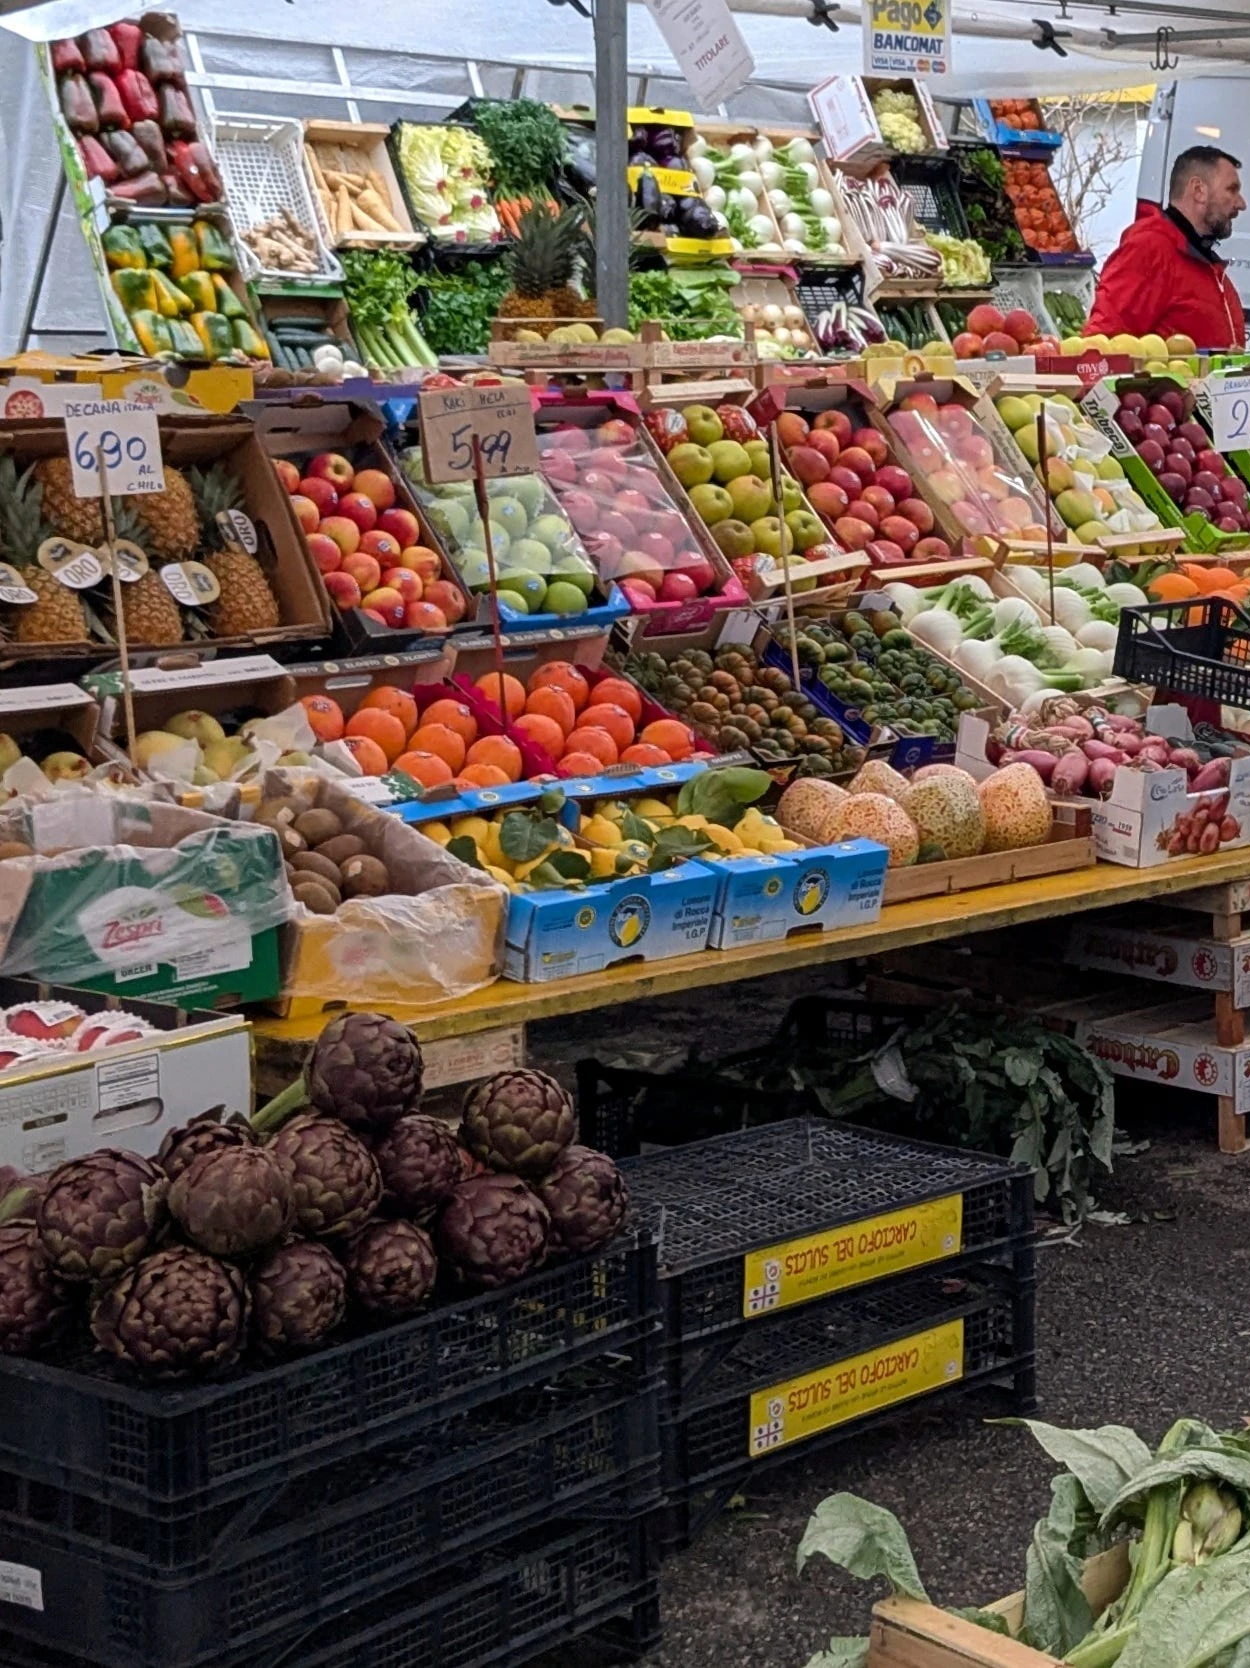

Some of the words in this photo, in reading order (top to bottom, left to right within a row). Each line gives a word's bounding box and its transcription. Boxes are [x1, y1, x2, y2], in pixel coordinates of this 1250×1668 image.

[873, 0, 922, 29] Pago
[694, 35, 730, 71] TITOLARE
[873, 32, 944, 54] BANCOMAT
[1077, 363, 1099, 378] envy
[66, 402, 121, 418] DECANA
[1085, 396, 1126, 452] Trybeca
[75, 431, 146, 473] 6,90
[234, 515, 254, 546] ORO
[63, 559, 98, 585] ORO
[164, 572, 192, 600] ORO
[672, 920, 708, 932] Imperiale
[685, 907, 710, 917] Rocca
[101, 918, 164, 949] Zespri
[836, 1236, 854, 1262] DEL
[858, 1219, 917, 1253] CARCIOFO
[785, 1246, 829, 1276] SULCIS
[836, 1364, 857, 1395] DEL
[861, 1347, 919, 1388] CARCIOFO
[788, 1376, 833, 1413] SULCIS
